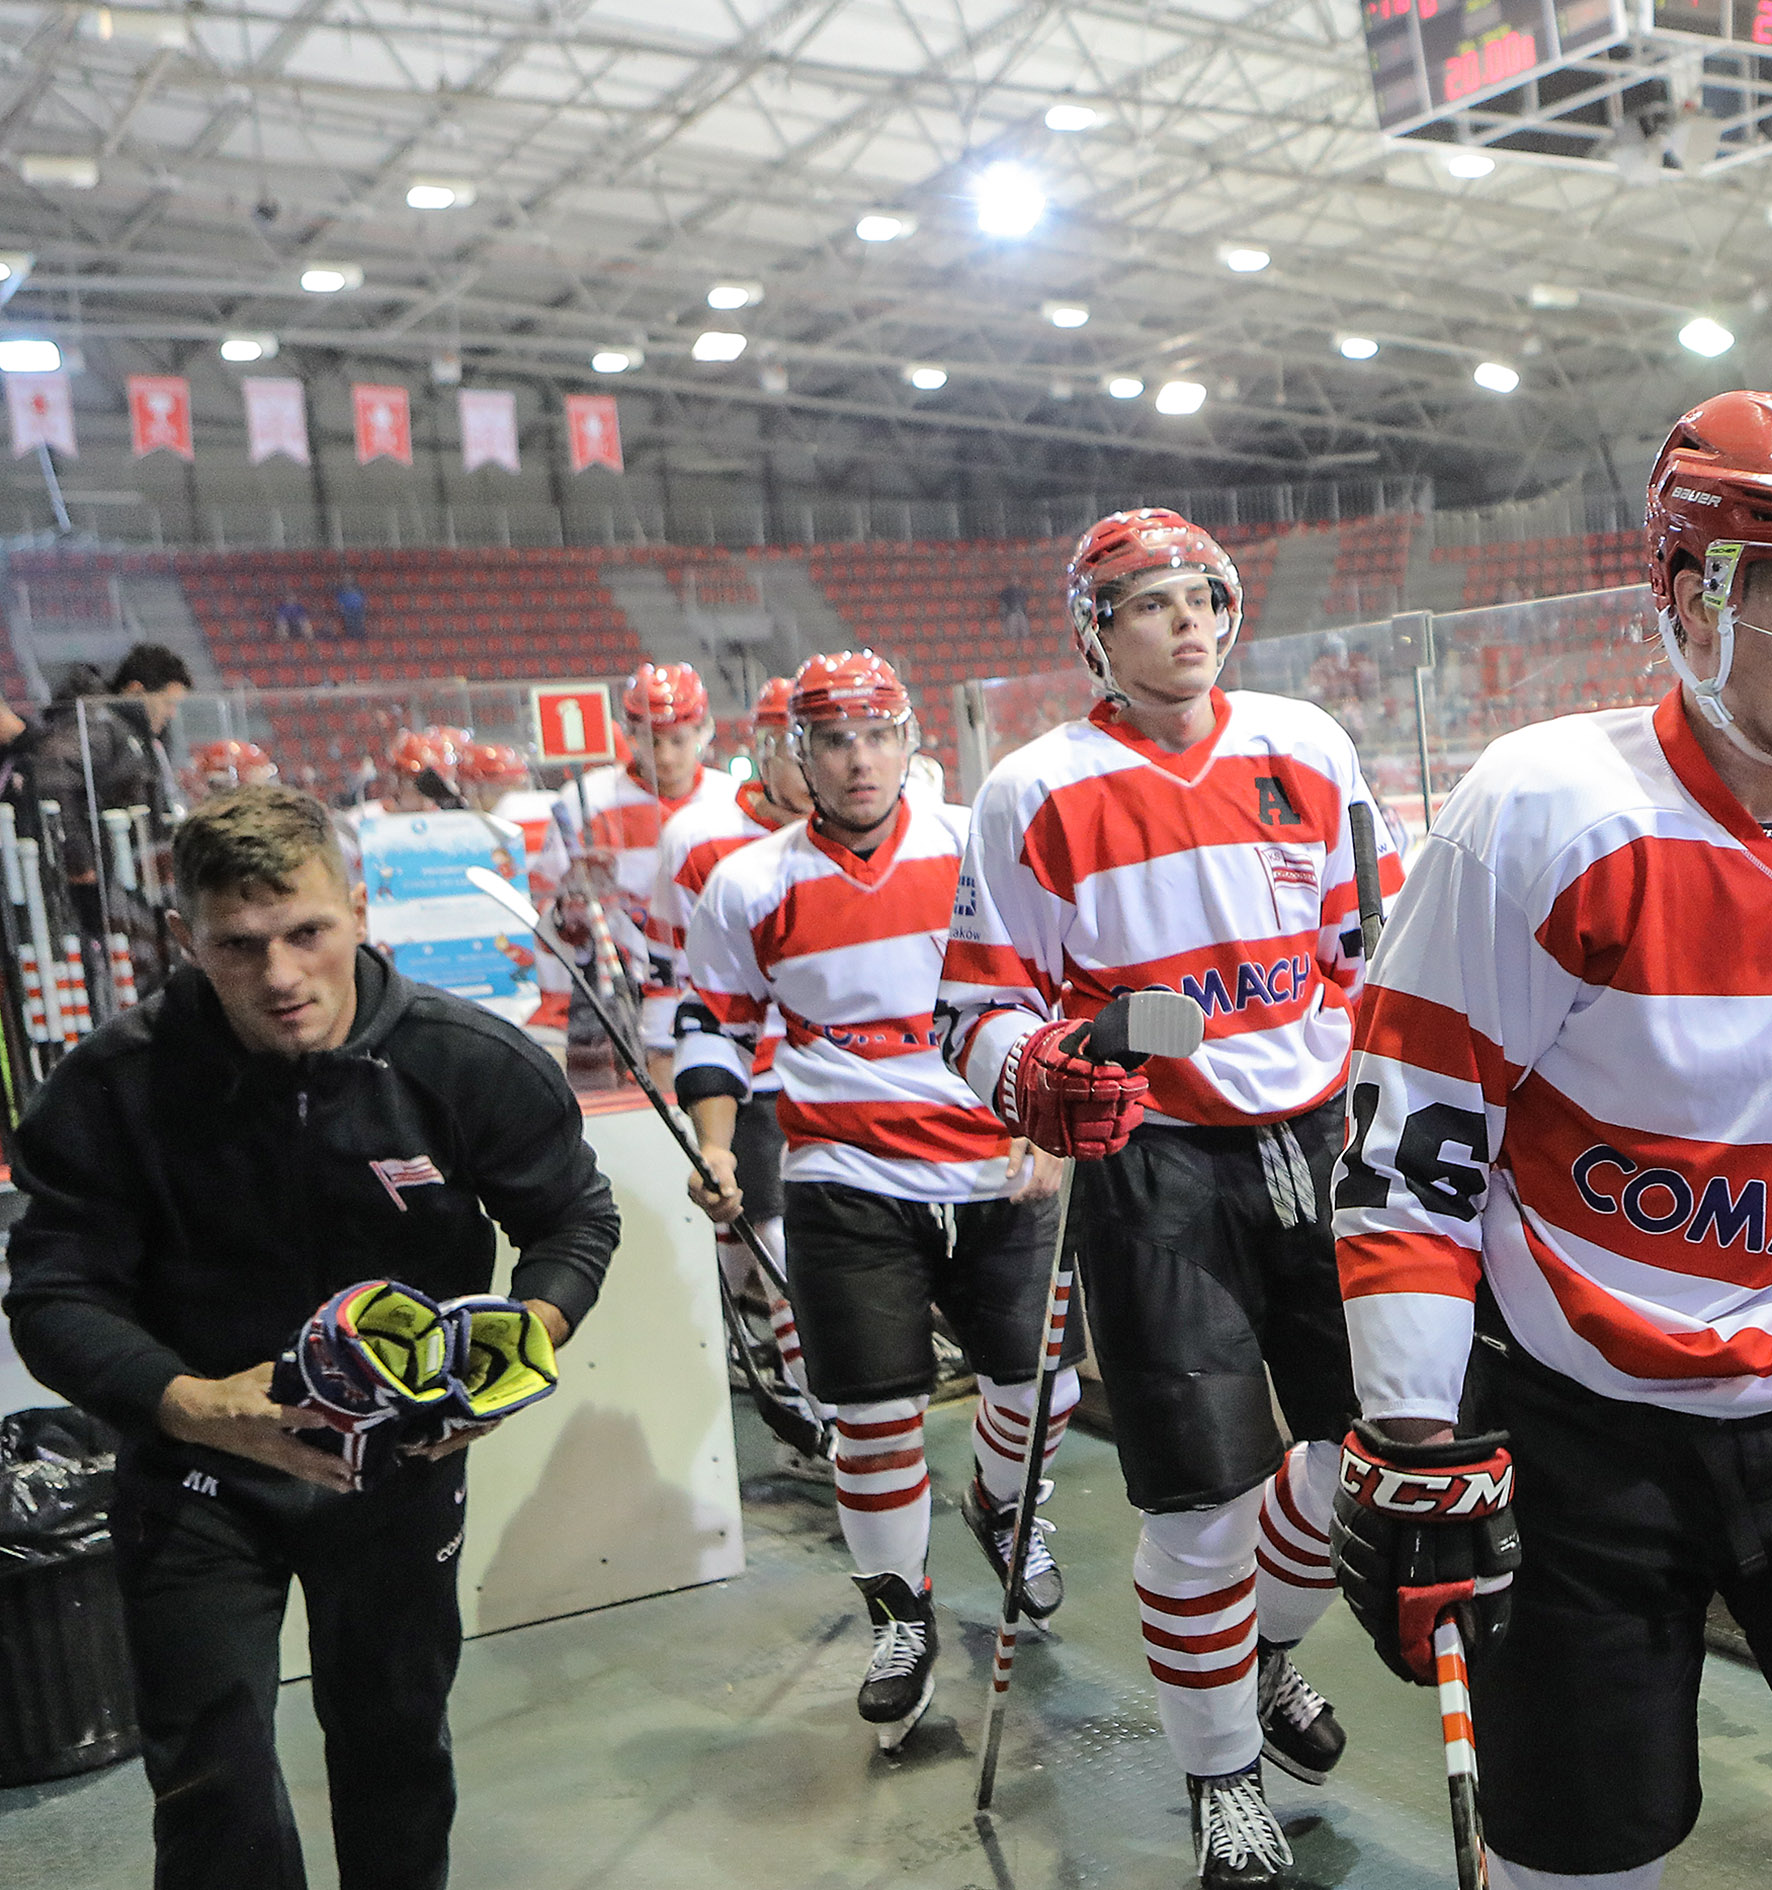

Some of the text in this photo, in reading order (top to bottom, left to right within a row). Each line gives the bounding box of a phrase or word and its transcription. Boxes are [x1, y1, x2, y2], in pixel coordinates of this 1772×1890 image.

[1255, 776, 1301, 826] A
[1335, 1082, 1489, 1222] 16
[1340, 1447, 1513, 1515] CCM
